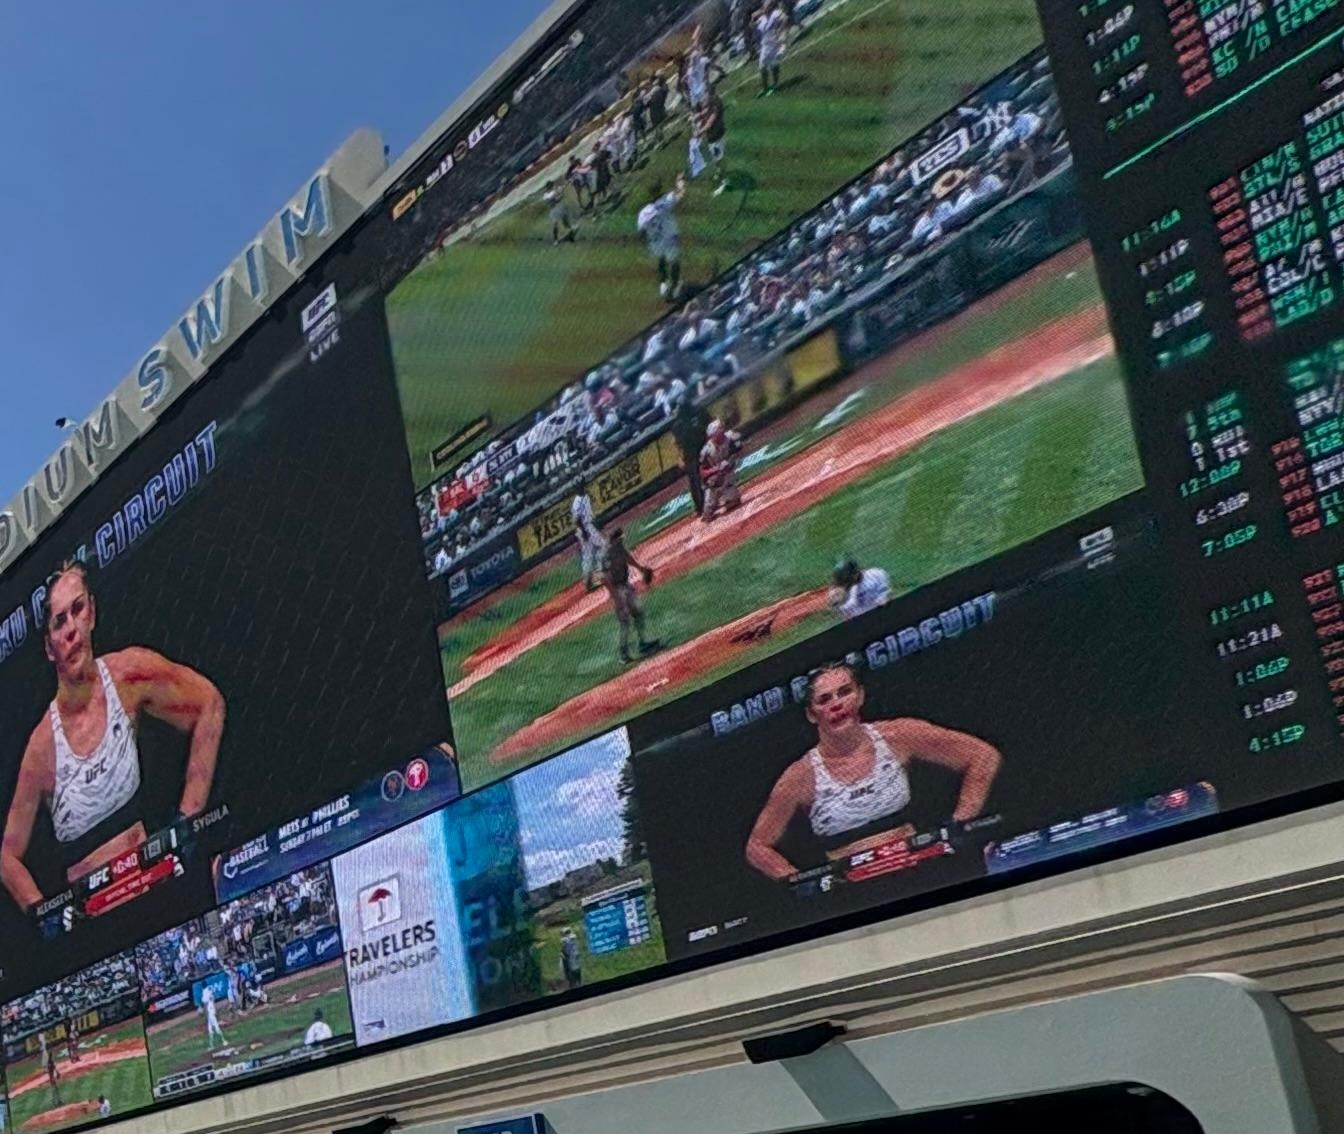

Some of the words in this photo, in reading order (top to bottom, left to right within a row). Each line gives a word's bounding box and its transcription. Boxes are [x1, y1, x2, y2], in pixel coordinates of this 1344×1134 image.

[136, 170, 335, 414] SWIM
[95, 420, 217, 568] CIRCUIT
[710, 686, 784, 738] BAKU
[865, 590, 997, 671] CIRCUIT
[85, 757, 107, 784] UFC
[89, 867, 110, 890] UFC
[345, 920, 436, 967] RAVELERS
